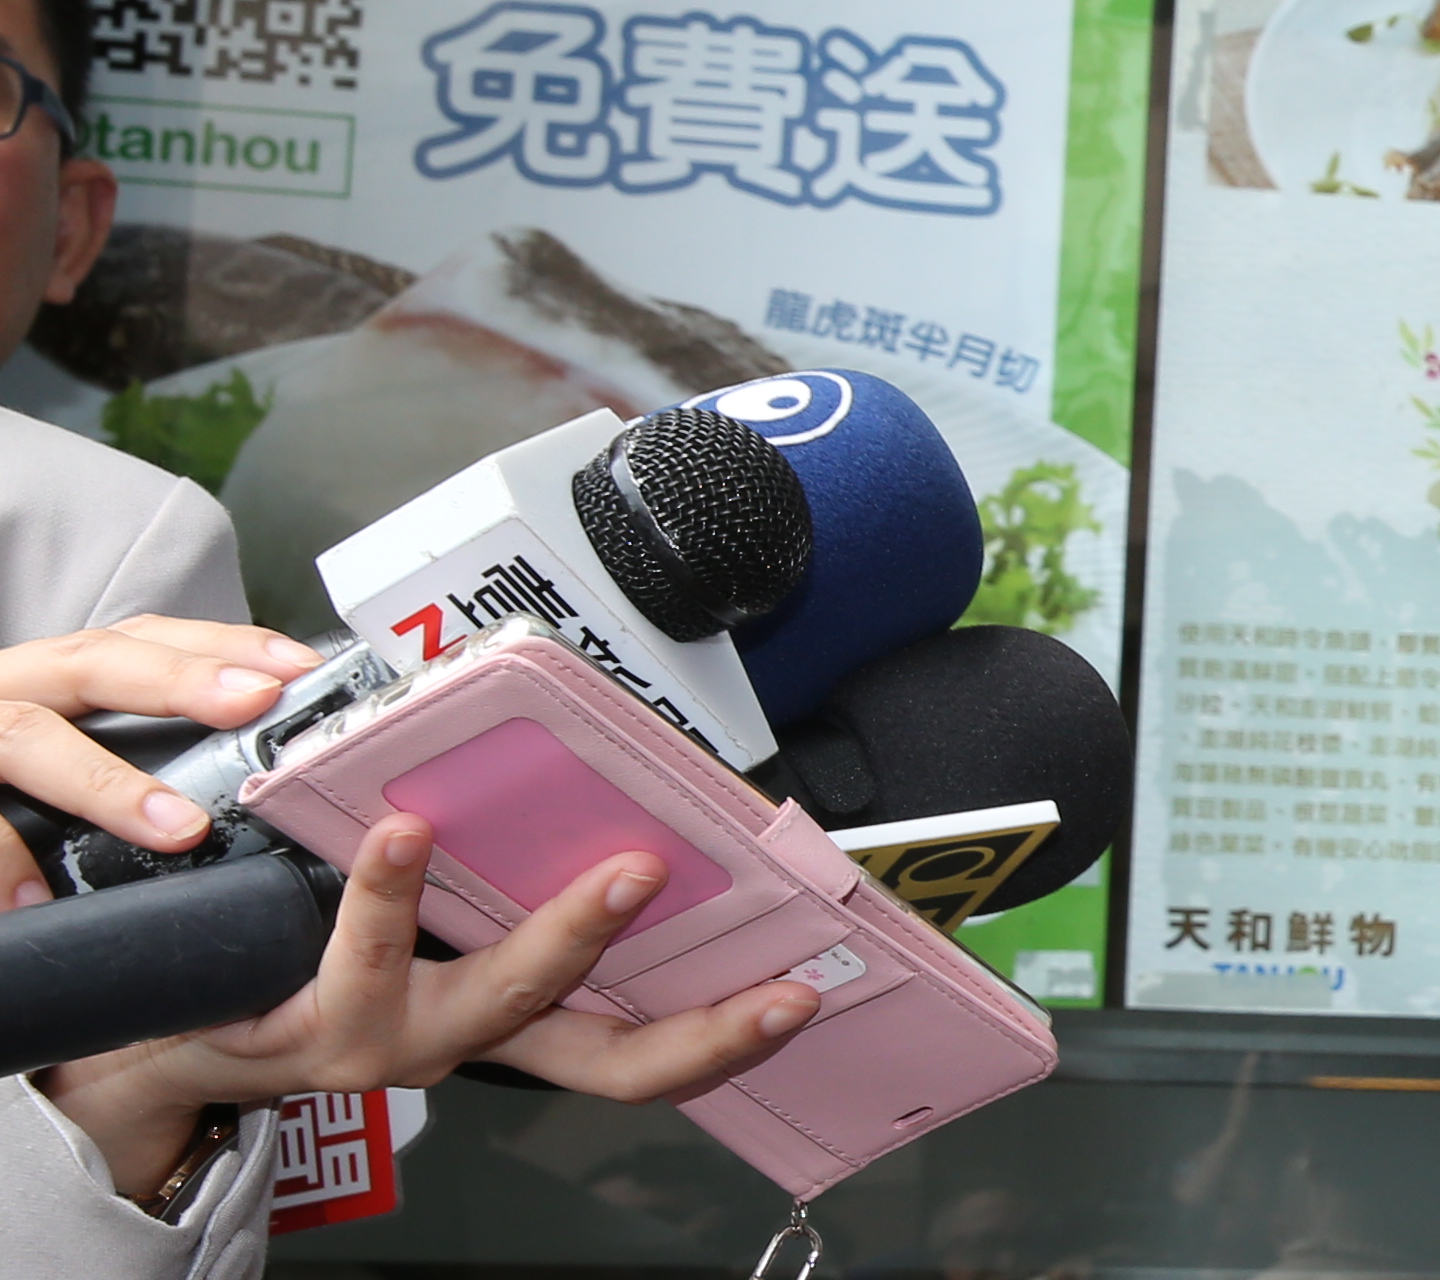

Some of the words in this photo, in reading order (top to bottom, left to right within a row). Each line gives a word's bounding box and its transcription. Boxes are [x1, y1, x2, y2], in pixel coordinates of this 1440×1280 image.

[413, 0, 1007, 217] 免費送
[762, 287, 1041, 395] 龍虎斑半月切
[1165, 906, 1398, 958] 天和鮮物
